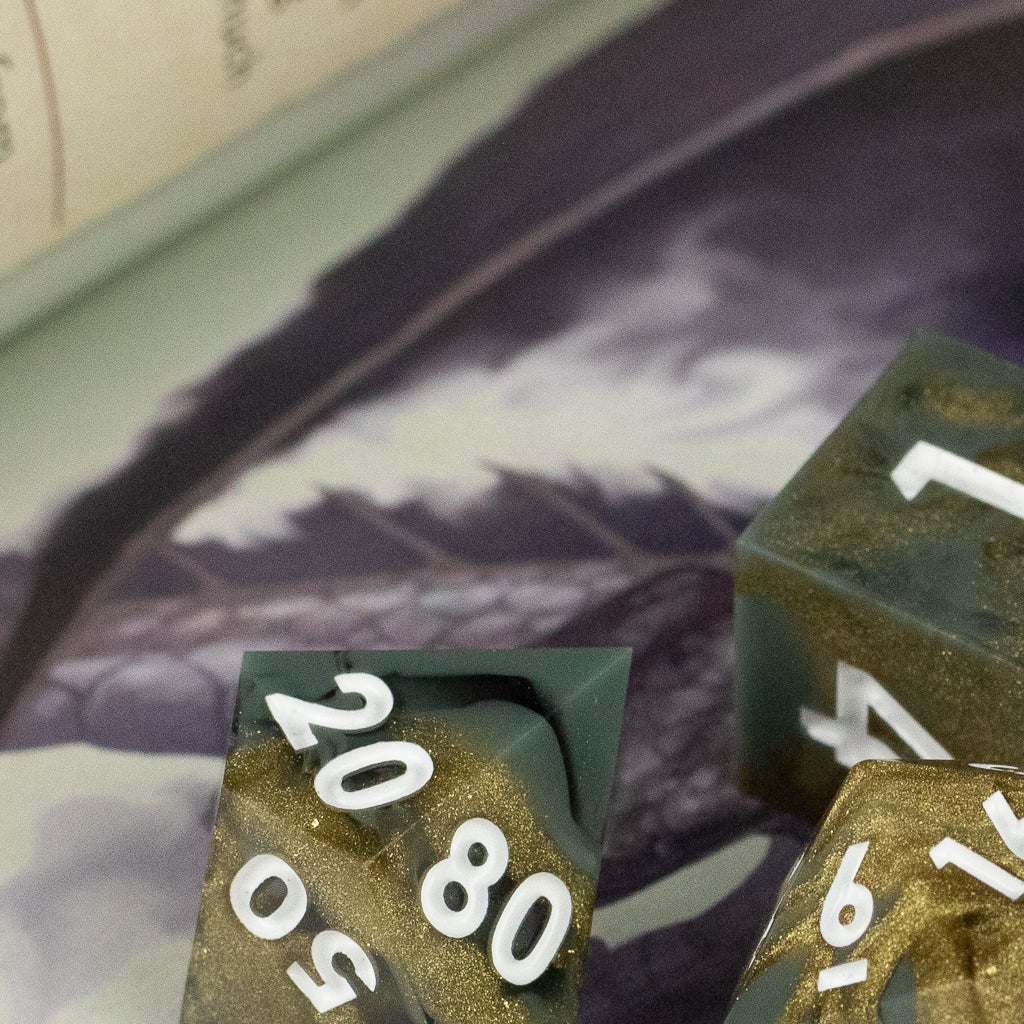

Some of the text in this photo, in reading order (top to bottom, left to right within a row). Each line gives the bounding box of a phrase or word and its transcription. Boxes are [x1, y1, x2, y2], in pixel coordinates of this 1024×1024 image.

[265, 673, 434, 811] 20
[799, 659, 956, 768] 4
[420, 817, 573, 986] 80
